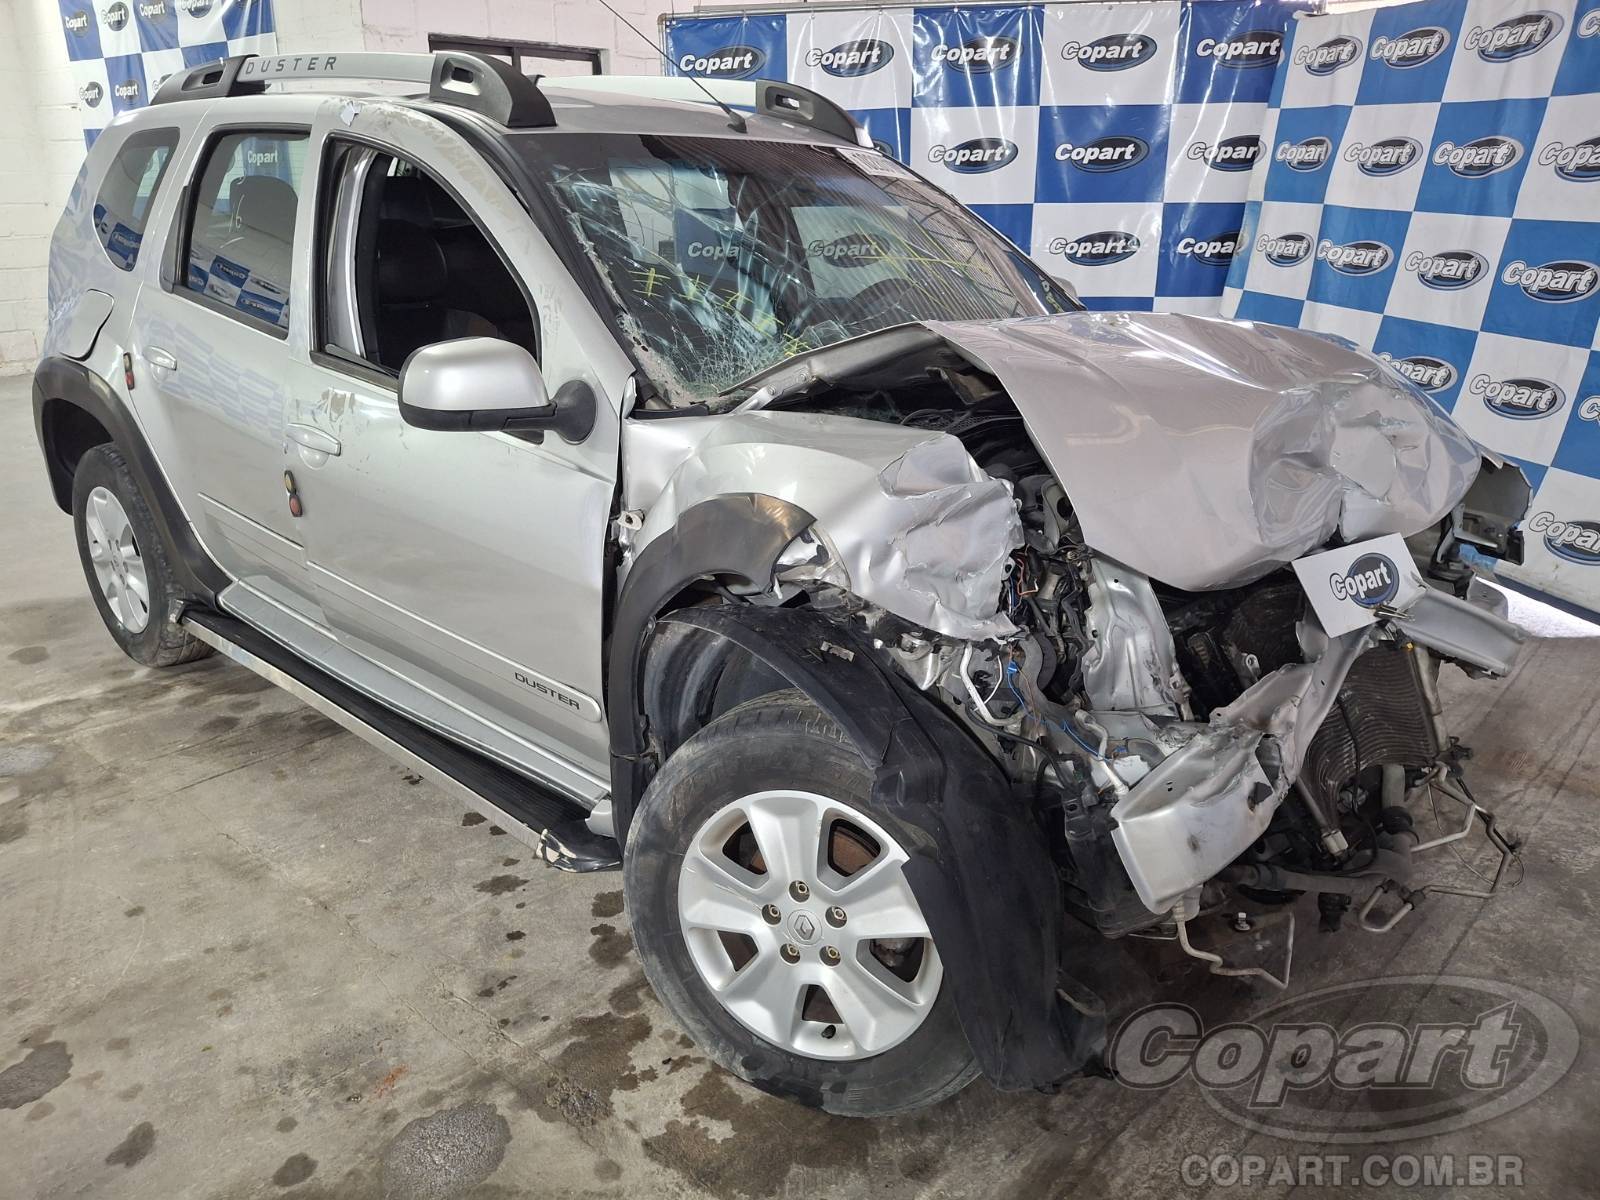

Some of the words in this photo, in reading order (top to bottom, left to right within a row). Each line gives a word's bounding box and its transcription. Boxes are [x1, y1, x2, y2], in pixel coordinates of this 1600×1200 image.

[1464, 15, 1549, 51] Copart
[806, 46, 881, 72] Copart
[931, 43, 1010, 64] Copart
[1061, 40, 1144, 61] Copart
[1196, 38, 1280, 60] Copart
[1294, 40, 1354, 66] Copart
[1371, 32, 1443, 63] Copart
[245, 56, 337, 75] DUSTER
[680, 50, 753, 76] Copart
[115, 83, 140, 99] Copart
[248, 149, 278, 166] Copart
[928, 144, 1004, 166] Copart
[1055, 142, 1136, 163] Copart
[1187, 142, 1259, 162] Copar
[1344, 142, 1414, 170] Copart
[1433, 142, 1511, 171] Copart
[807, 239, 877, 260] Copart
[1049, 237, 1127, 258] Copart
[1257, 234, 1310, 259] Copart
[1316, 240, 1388, 268] Copart
[1405, 251, 1479, 281] Copart
[1503, 261, 1595, 293] Copart
[1469, 374, 1554, 411] Copart
[1329, 561, 1391, 600] Copart
[515, 672, 580, 710] DUSTER
